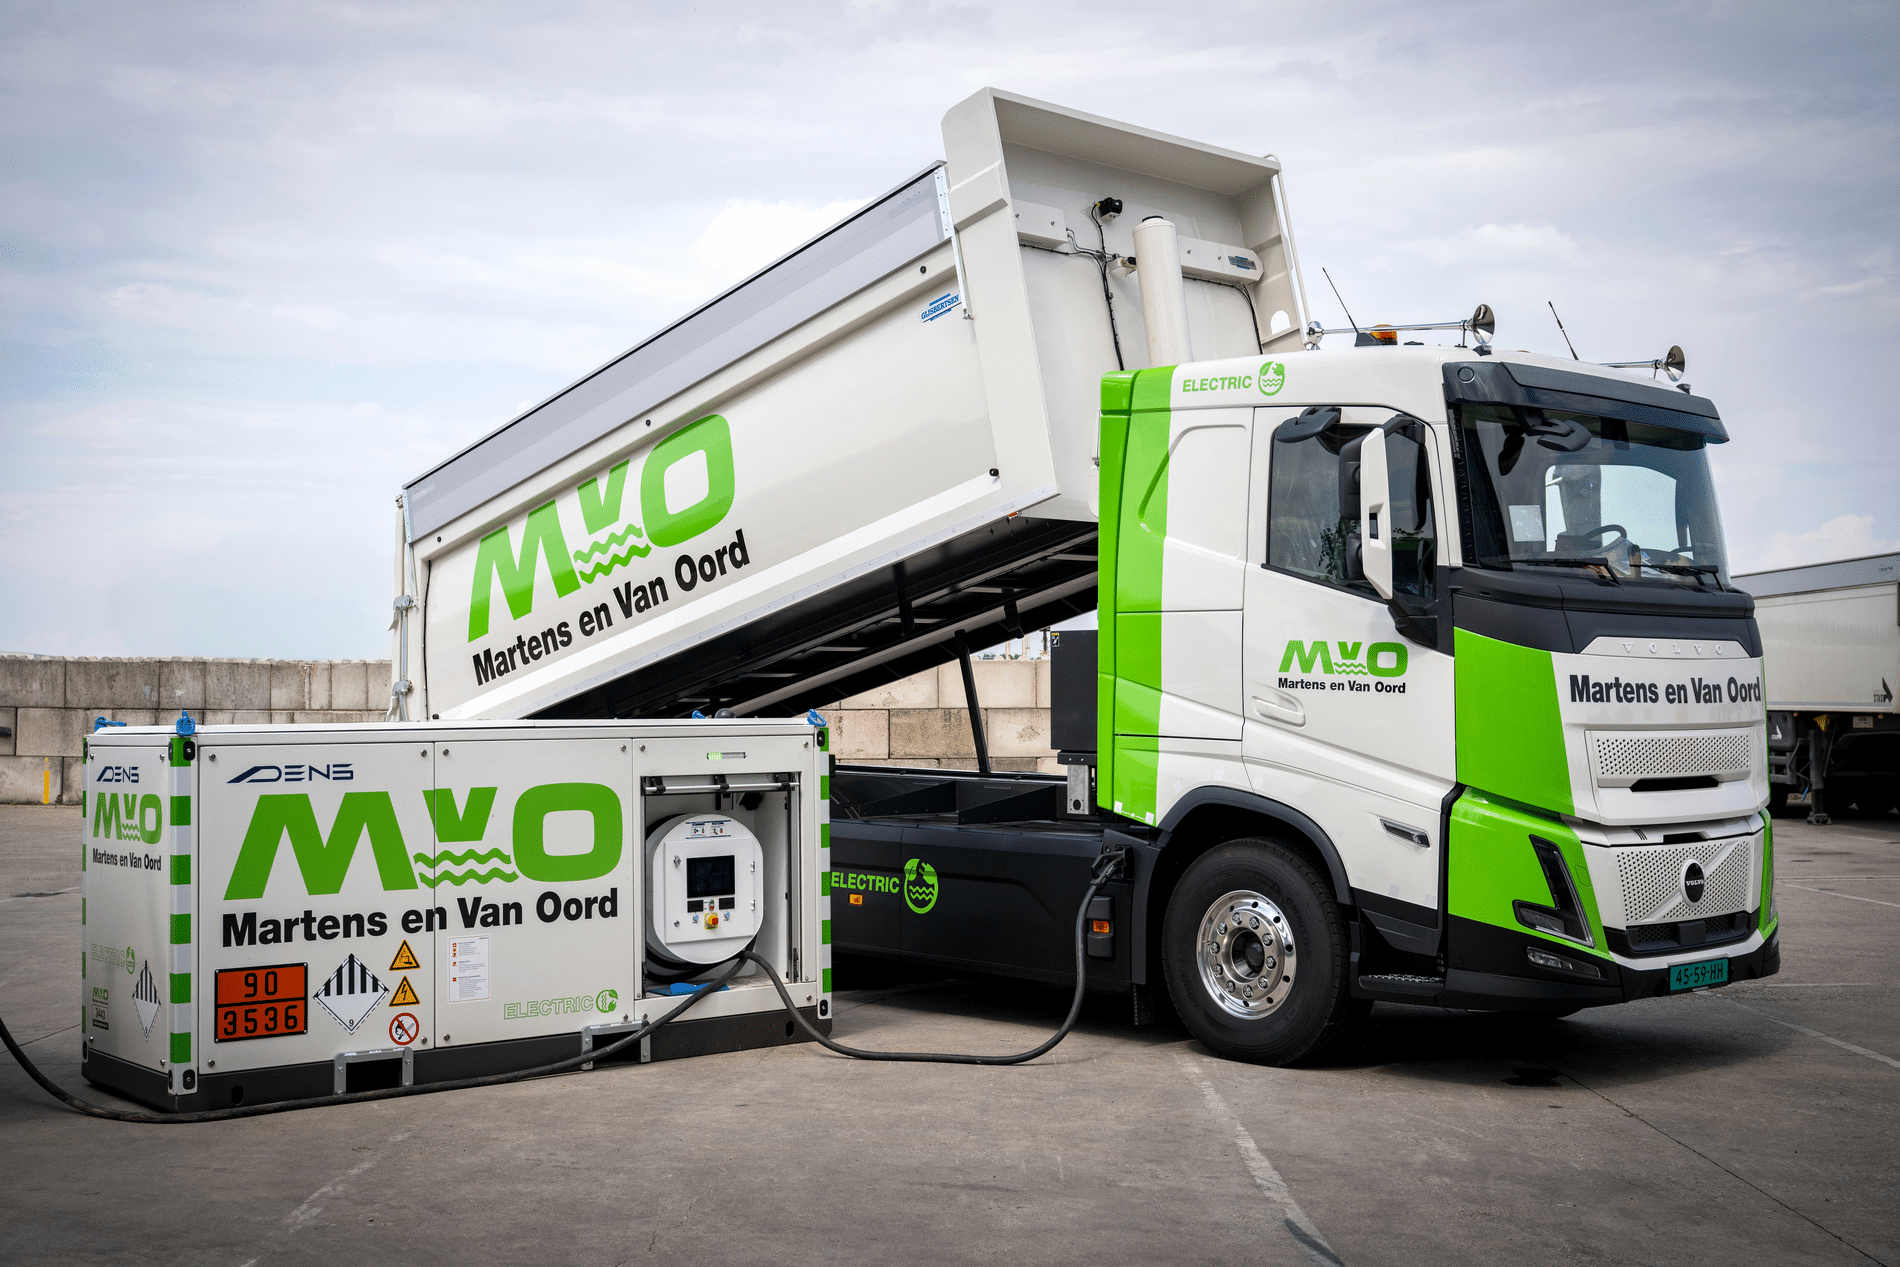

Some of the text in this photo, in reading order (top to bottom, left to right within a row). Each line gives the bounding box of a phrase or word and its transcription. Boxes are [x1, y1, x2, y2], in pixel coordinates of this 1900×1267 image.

[921, 294, 959, 320] GIJSBERTSEN
[1182, 375, 1253, 393] ELECTRIC
[472, 528, 751, 686] Martens en Van Oord
[1622, 642, 1723, 655] VOLVO
[1278, 677, 1406, 694] Martens en Van Oord
[1569, 674, 1761, 704] Martens en Van Oord
[96, 766, 140, 784] DENS
[226, 763, 354, 784] DENS
[92, 848, 162, 871] Martens en Van Oord
[830, 871, 900, 894] ELECTRIC
[222, 887, 618, 948] Martens en Van Oord
[91, 943, 126, 968] ELECTRIC
[244, 970, 278, 998] 90
[1675, 962, 1724, 985] 45-59-HH
[503, 995, 594, 1020] ELECTRIC
[223, 1004, 298, 1036] 3536
[348, 1019, 354, 1027] 9
